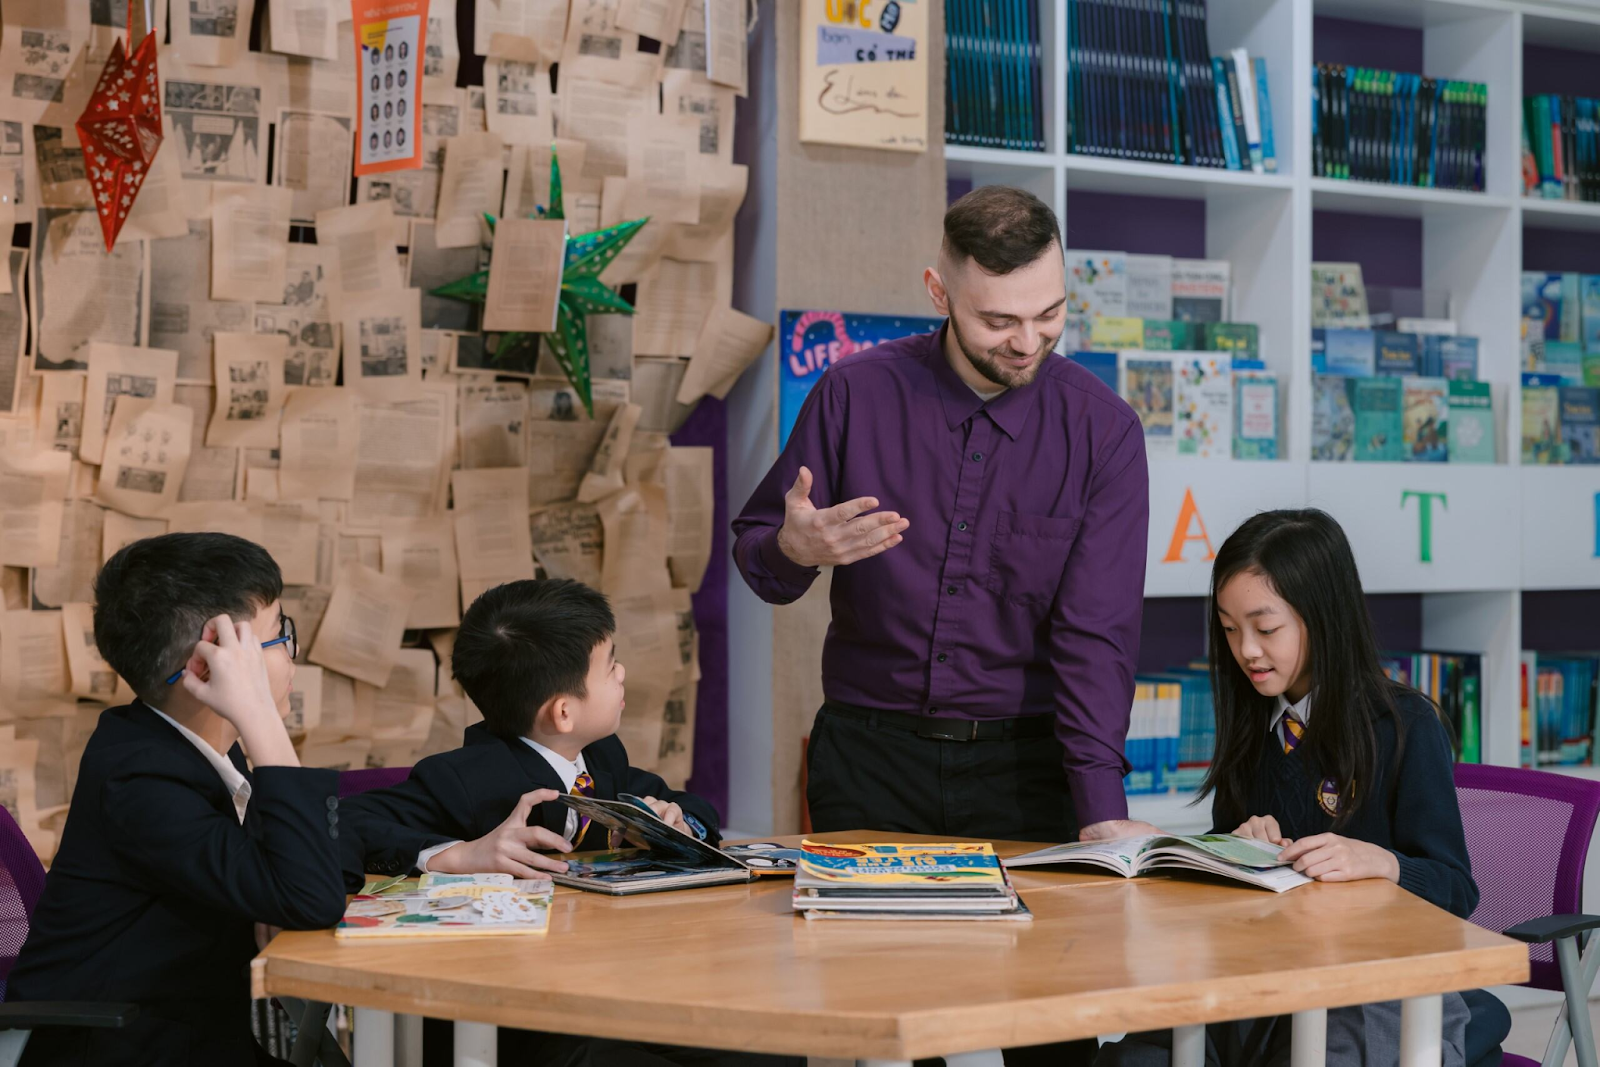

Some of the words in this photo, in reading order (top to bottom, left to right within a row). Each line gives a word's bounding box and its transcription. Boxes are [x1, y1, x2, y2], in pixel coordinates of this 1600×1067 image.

[789, 340, 842, 377] LIFE
[1161, 487, 1216, 563] A
[1400, 490, 1448, 563] T
